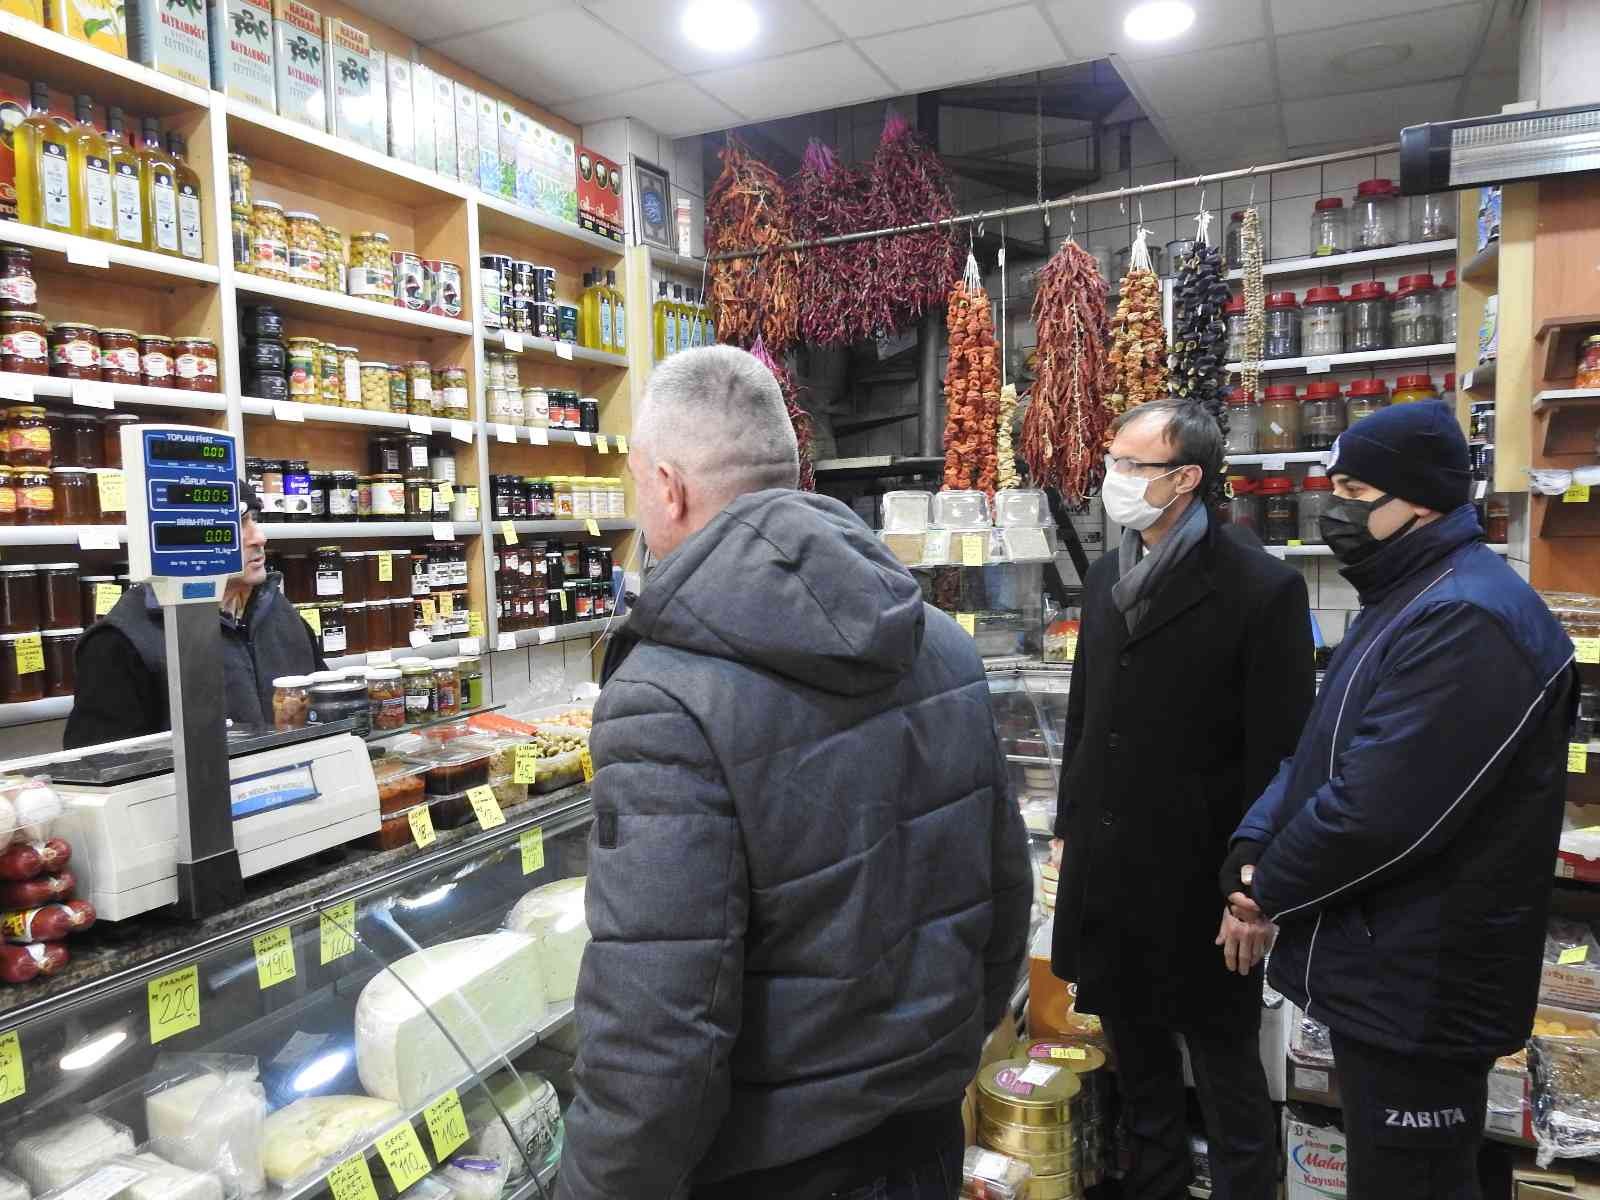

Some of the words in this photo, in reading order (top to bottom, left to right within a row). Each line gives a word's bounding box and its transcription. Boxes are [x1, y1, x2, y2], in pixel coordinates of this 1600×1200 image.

[166, 433, 195, 444] TOPLAM
[159, 984, 196, 1024] 220
[1384, 1107, 1467, 1128] ZABITA
